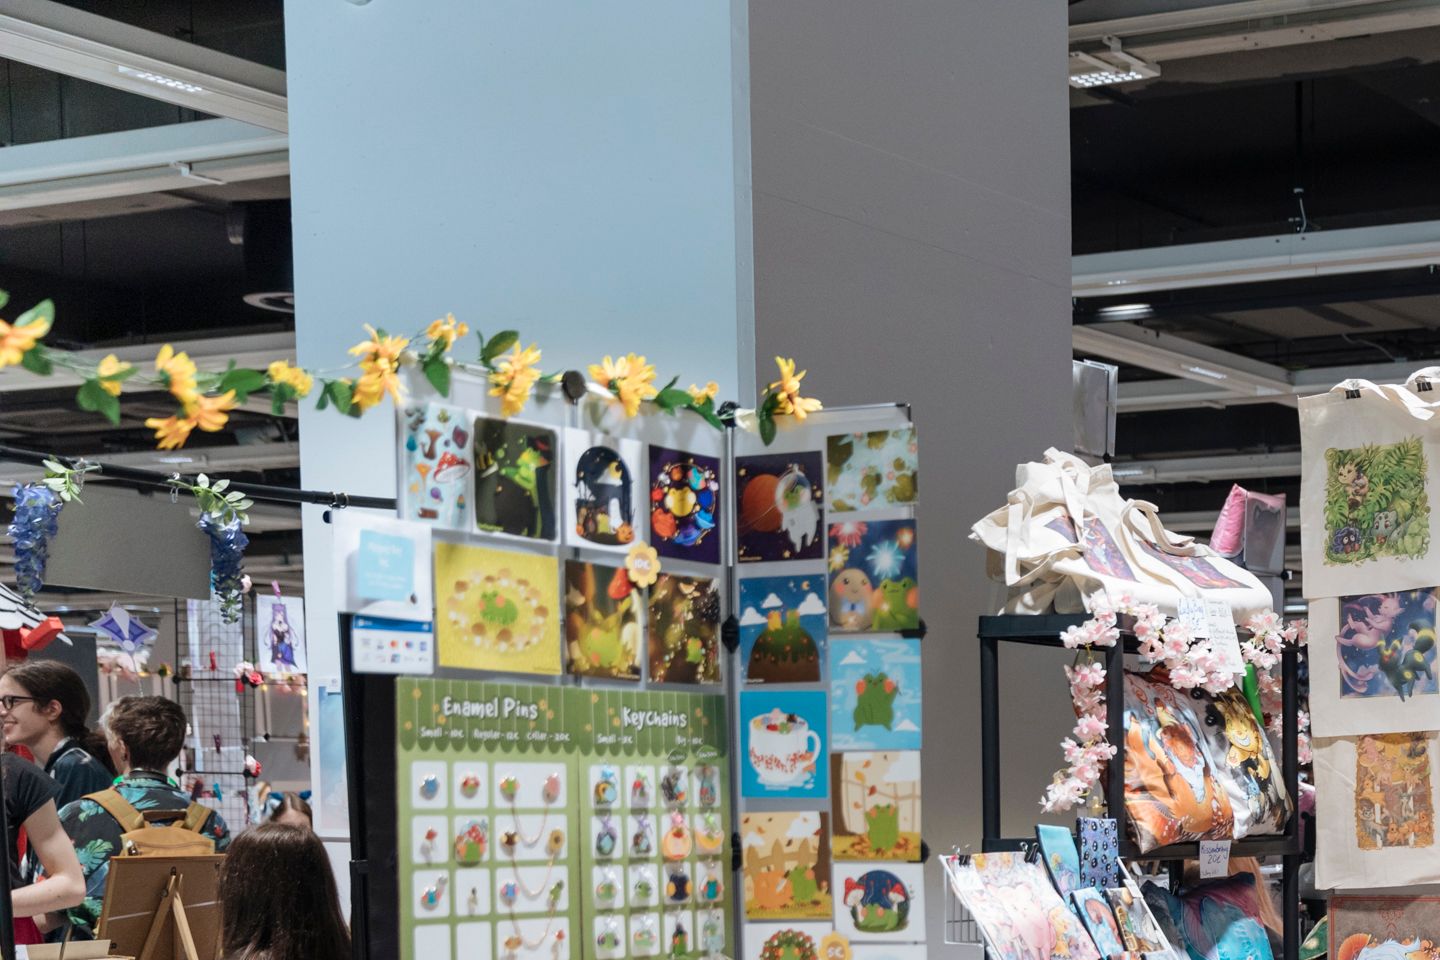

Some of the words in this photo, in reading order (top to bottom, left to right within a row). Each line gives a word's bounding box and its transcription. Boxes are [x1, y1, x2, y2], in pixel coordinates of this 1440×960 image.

[442, 696, 499, 719] Enamel
[504, 697, 538, 720] Pins
[420, 727, 442, 738] Small
